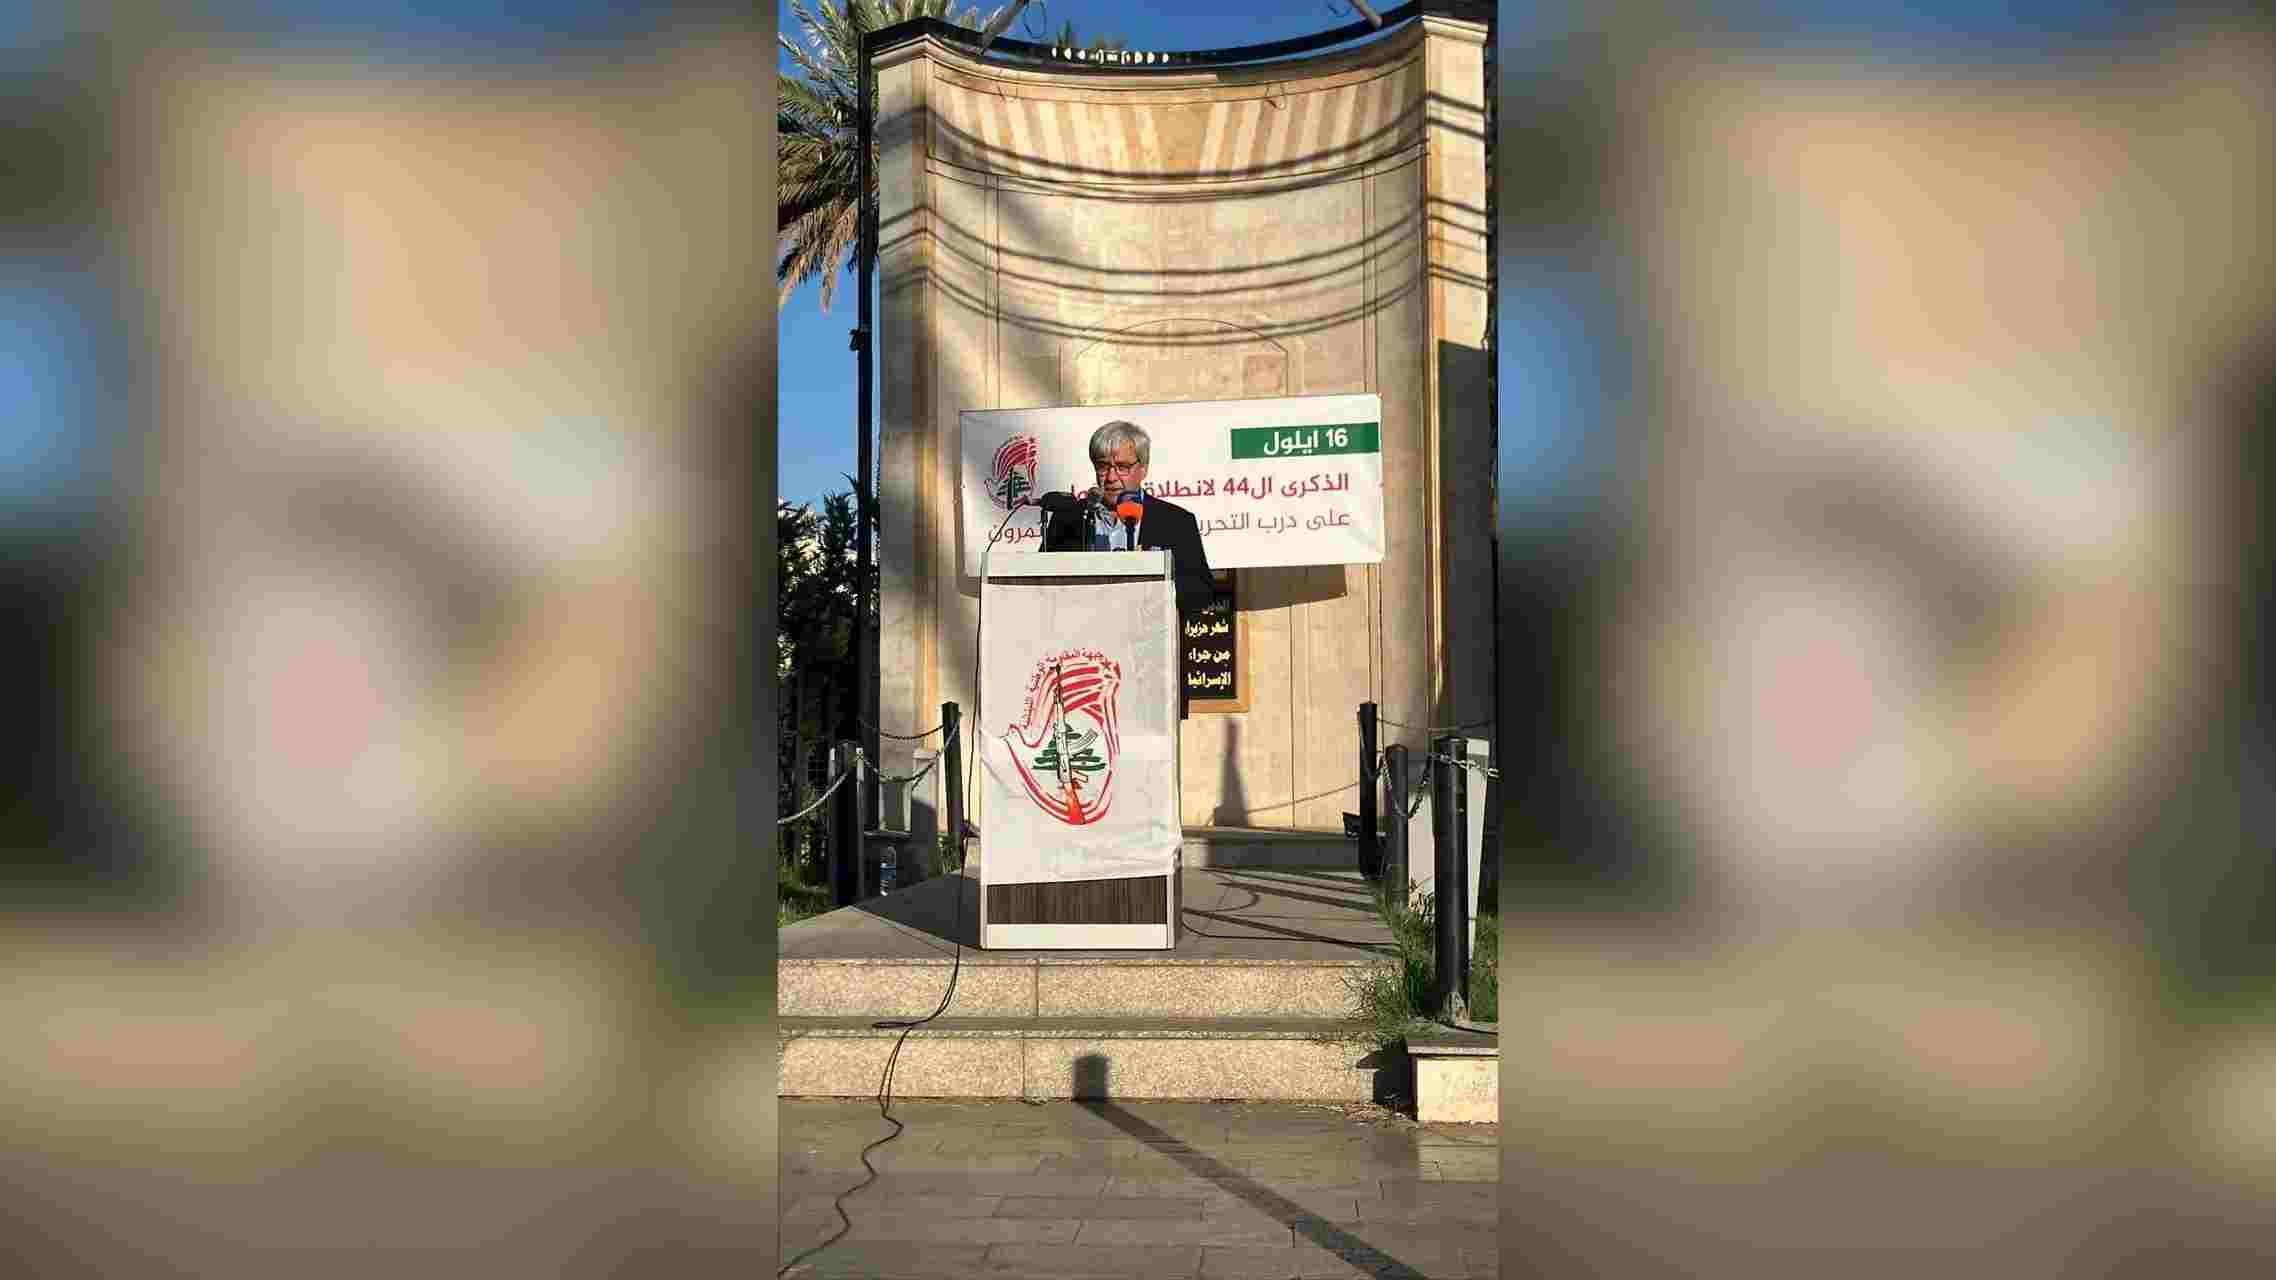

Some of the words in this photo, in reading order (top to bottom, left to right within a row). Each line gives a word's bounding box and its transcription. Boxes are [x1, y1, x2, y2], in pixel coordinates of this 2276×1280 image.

[1263, 430, 1319, 455] ايلول
[1325, 428, 1349, 448] 16
[1143, 478, 1216, 498] لانطلاق
[1281, 472, 1350, 498] الذكرى
[1199, 512, 1250, 537] التحري
[1257, 515, 1298, 534] درب
[1306, 507, 1351, 531] على
[1184, 618, 1209, 638] حزيرا
[1188, 647, 1212, 664] جراء
[1213, 649, 1231, 663] من
